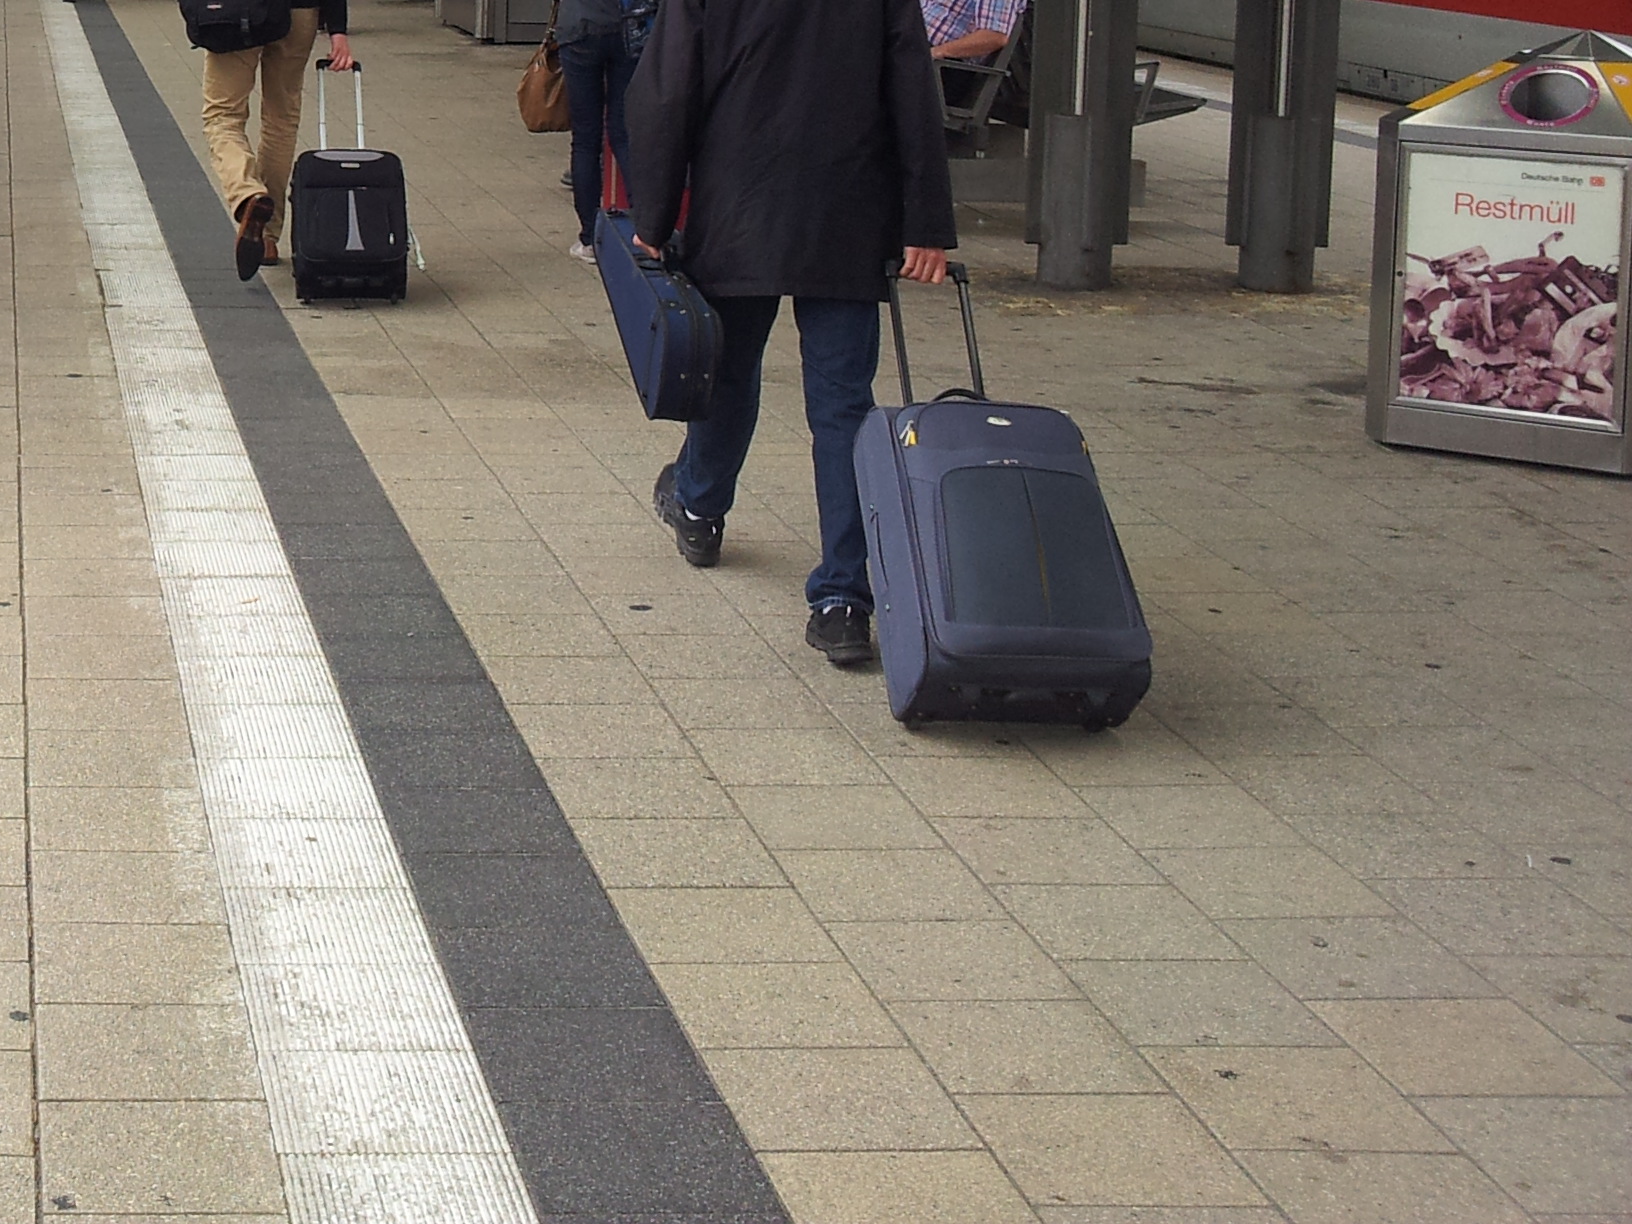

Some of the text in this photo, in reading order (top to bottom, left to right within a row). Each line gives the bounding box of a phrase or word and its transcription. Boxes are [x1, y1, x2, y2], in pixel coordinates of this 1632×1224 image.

[1521, 172, 1560, 182] Deutsche
[1562, 175, 1583, 185] Bahn
[1454, 192, 1575, 225] Restmüll
